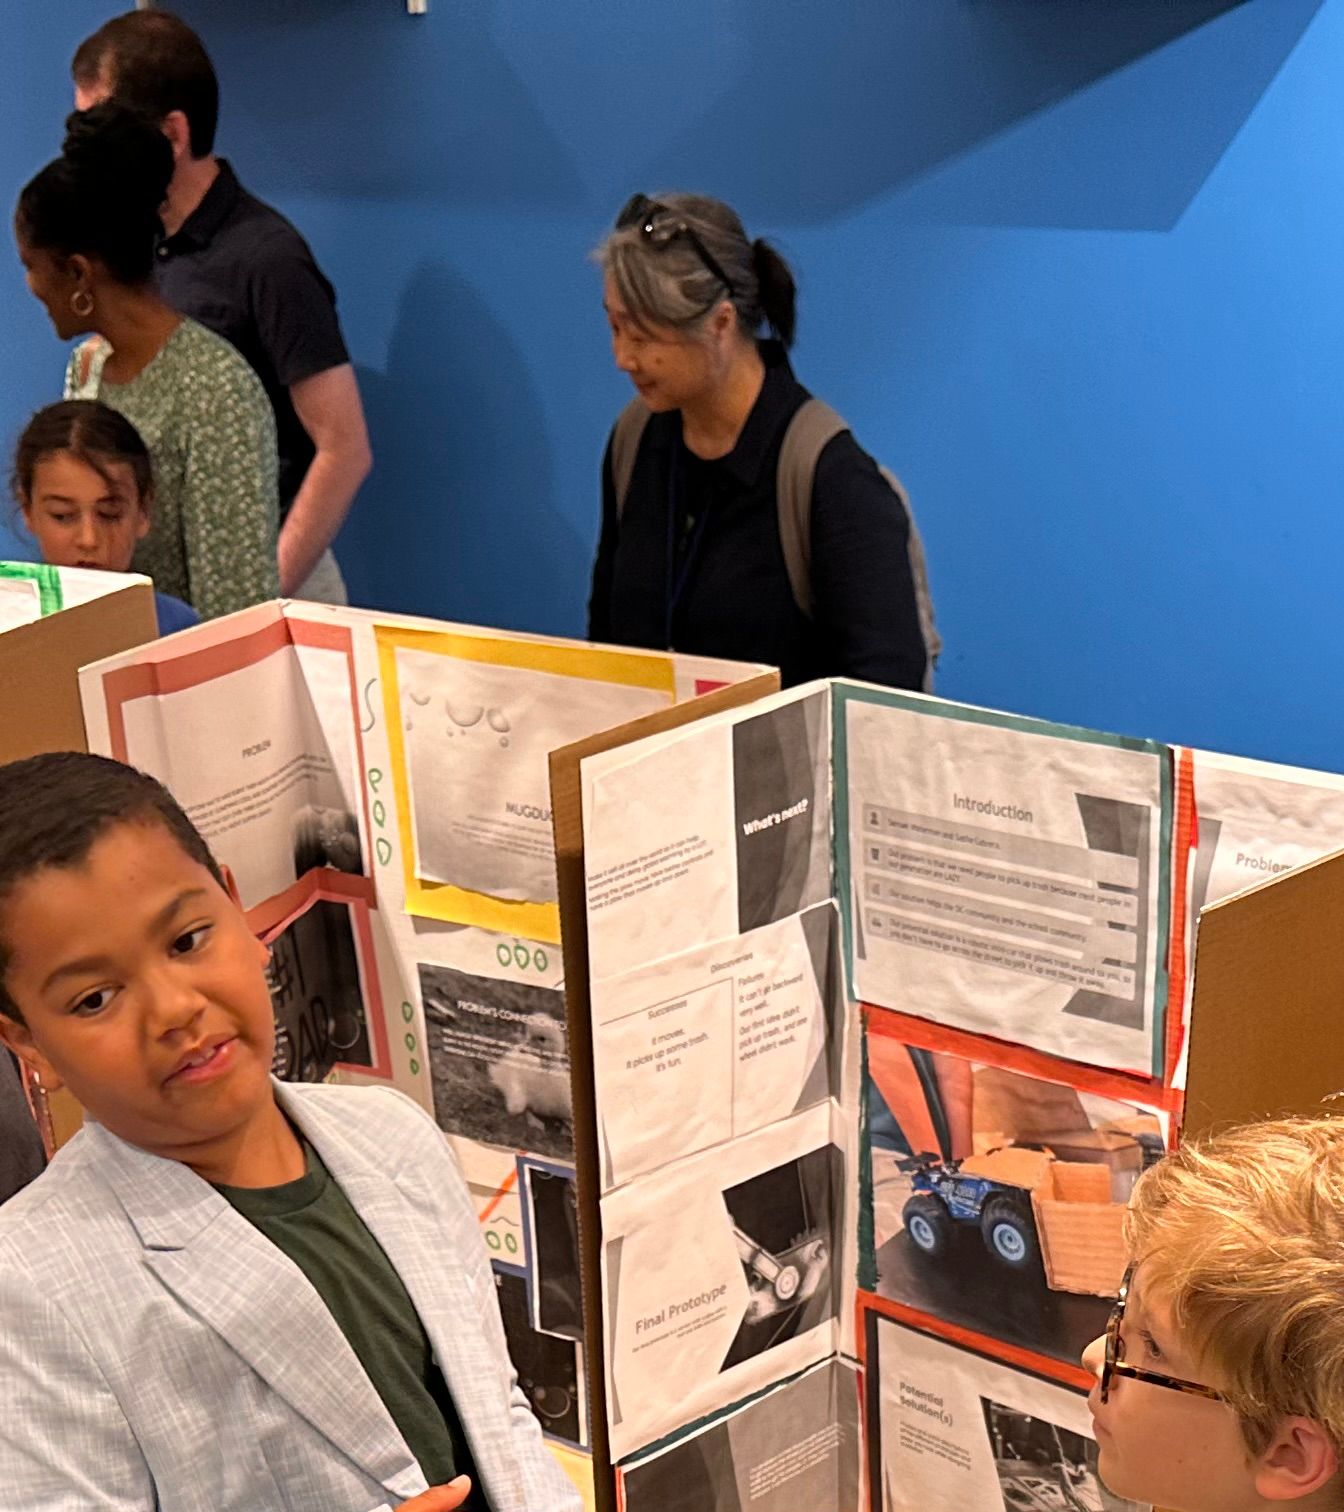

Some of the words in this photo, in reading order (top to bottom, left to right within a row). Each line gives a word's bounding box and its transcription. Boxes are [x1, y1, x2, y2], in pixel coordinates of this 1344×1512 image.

[506, 801, 552, 822] MUGDU
[743, 812, 781, 836] What's
[781, 798, 809, 821] next?
[953, 792, 1033, 822] Introduction
[635, 1309, 665, 1334] Final
[669, 1284, 727, 1319] Prototype
[900, 1381, 944, 1408] Potential
